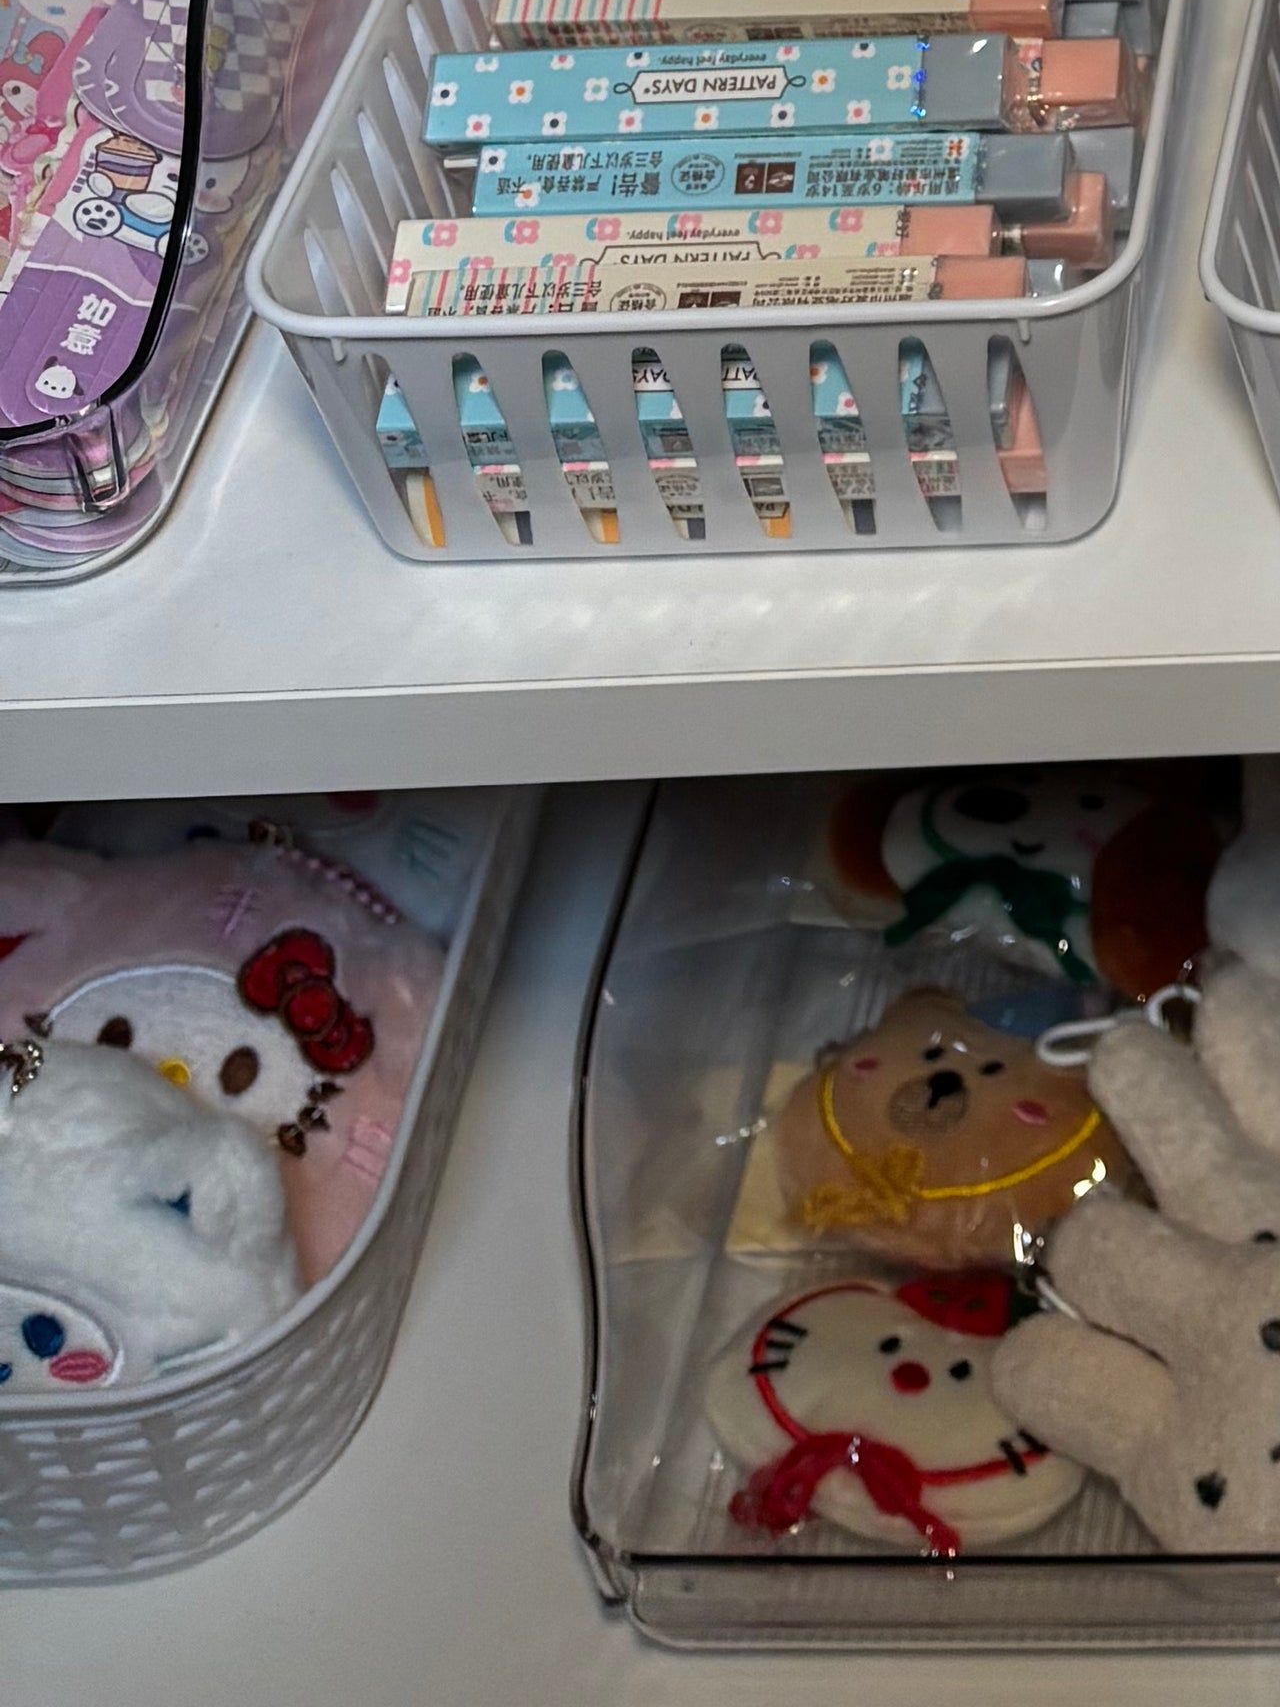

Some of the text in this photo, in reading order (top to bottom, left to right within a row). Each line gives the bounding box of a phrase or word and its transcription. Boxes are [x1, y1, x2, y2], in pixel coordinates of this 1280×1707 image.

[719, 52, 768, 66] everyday
[703, 74, 778, 91] PATTERN
[691, 226, 741, 240] everyday
[59, 292, 118, 357] 如意
